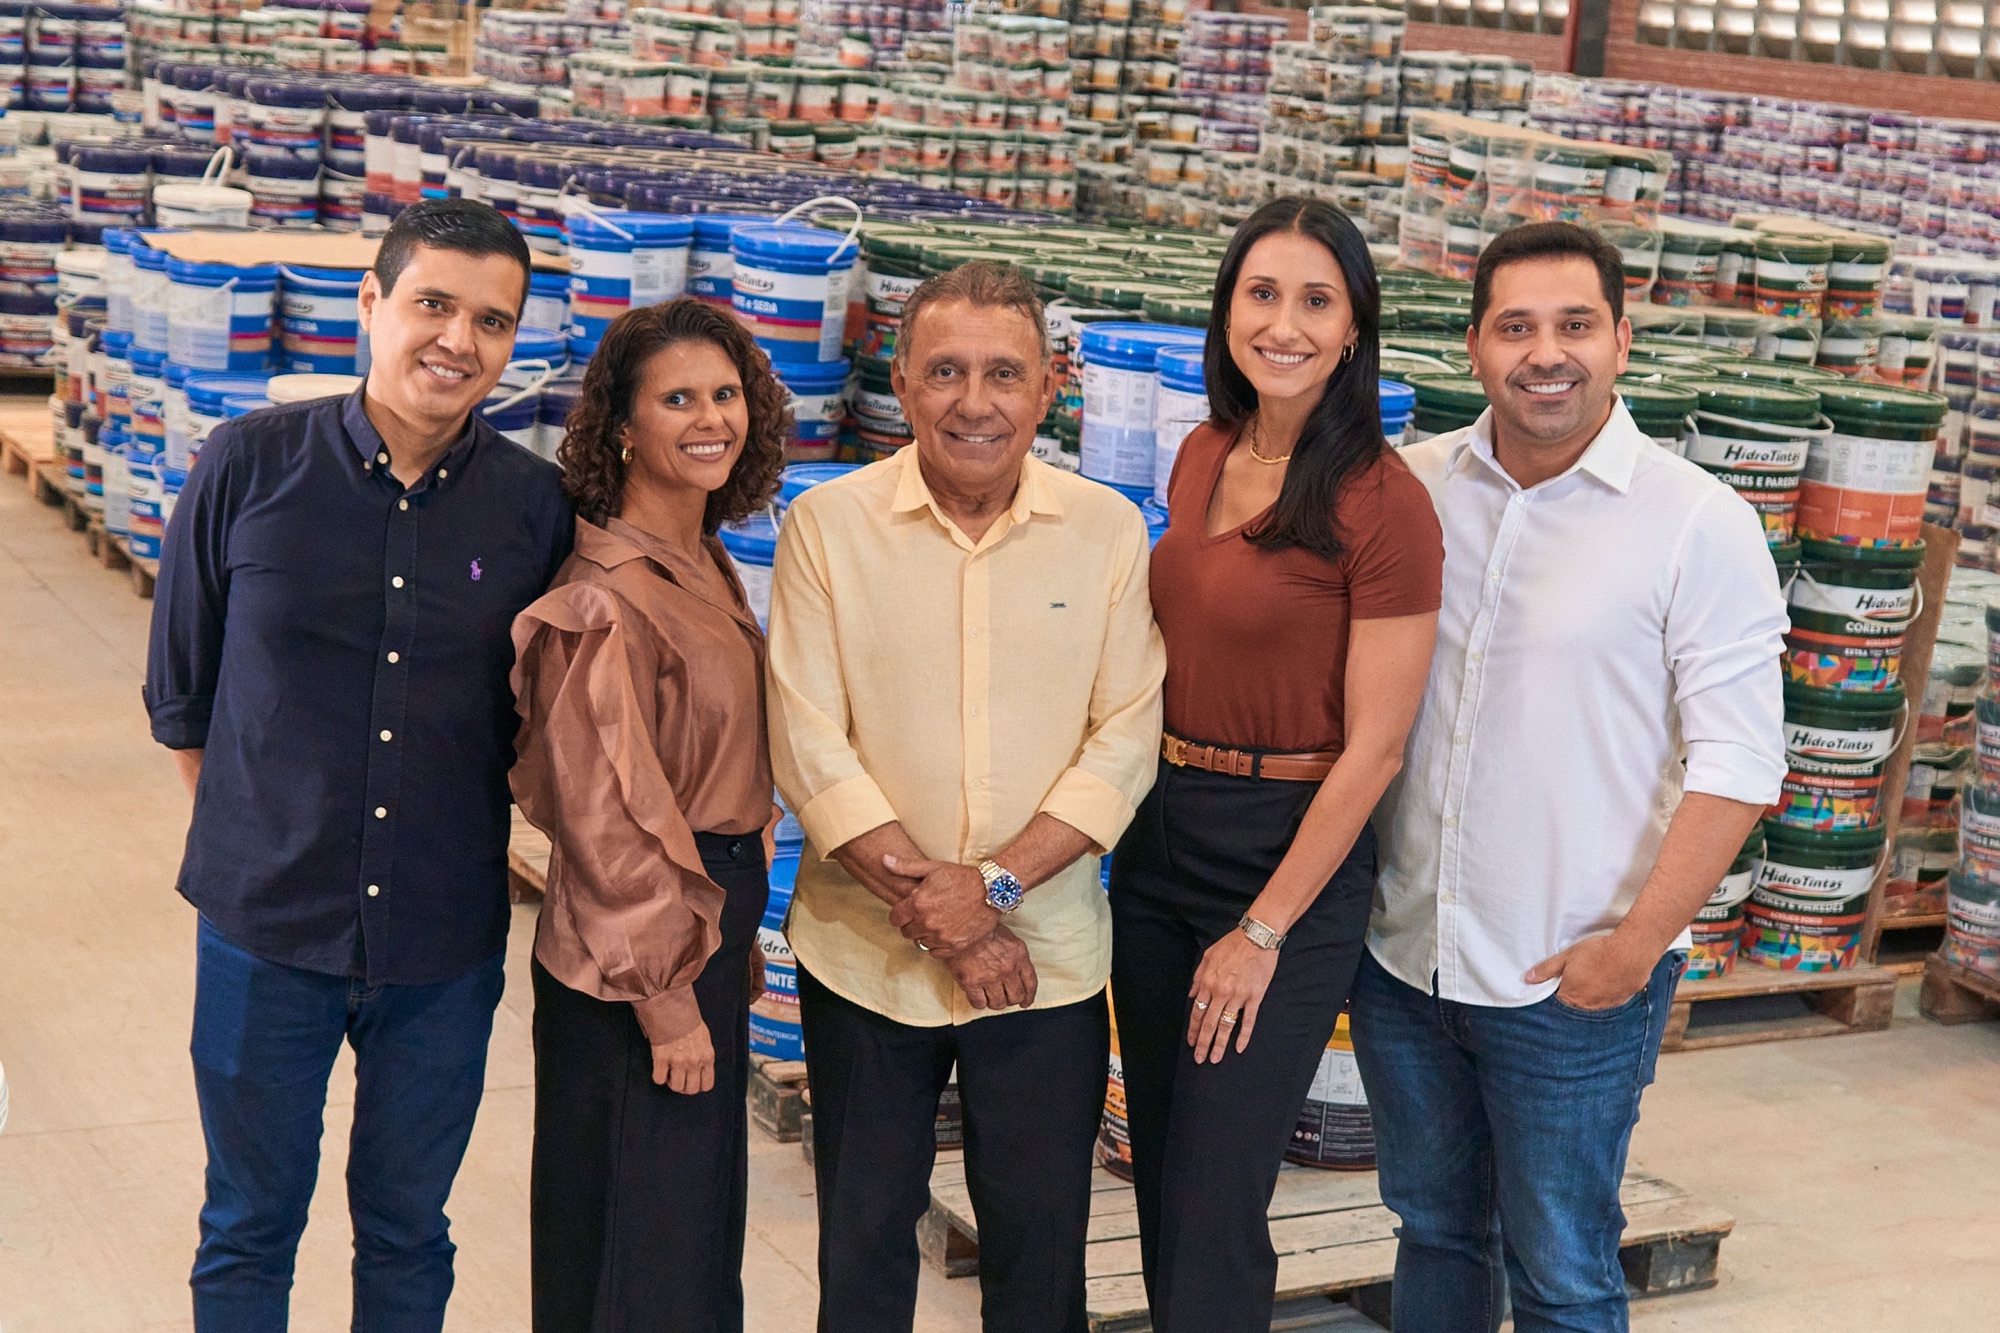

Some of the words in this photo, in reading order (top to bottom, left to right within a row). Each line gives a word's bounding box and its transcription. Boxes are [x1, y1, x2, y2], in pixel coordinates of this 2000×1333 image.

[1756, 476, 1763, 487] E
[1791, 730, 1874, 751] HidroTintas
[1761, 865, 1842, 889] HidroTintas
